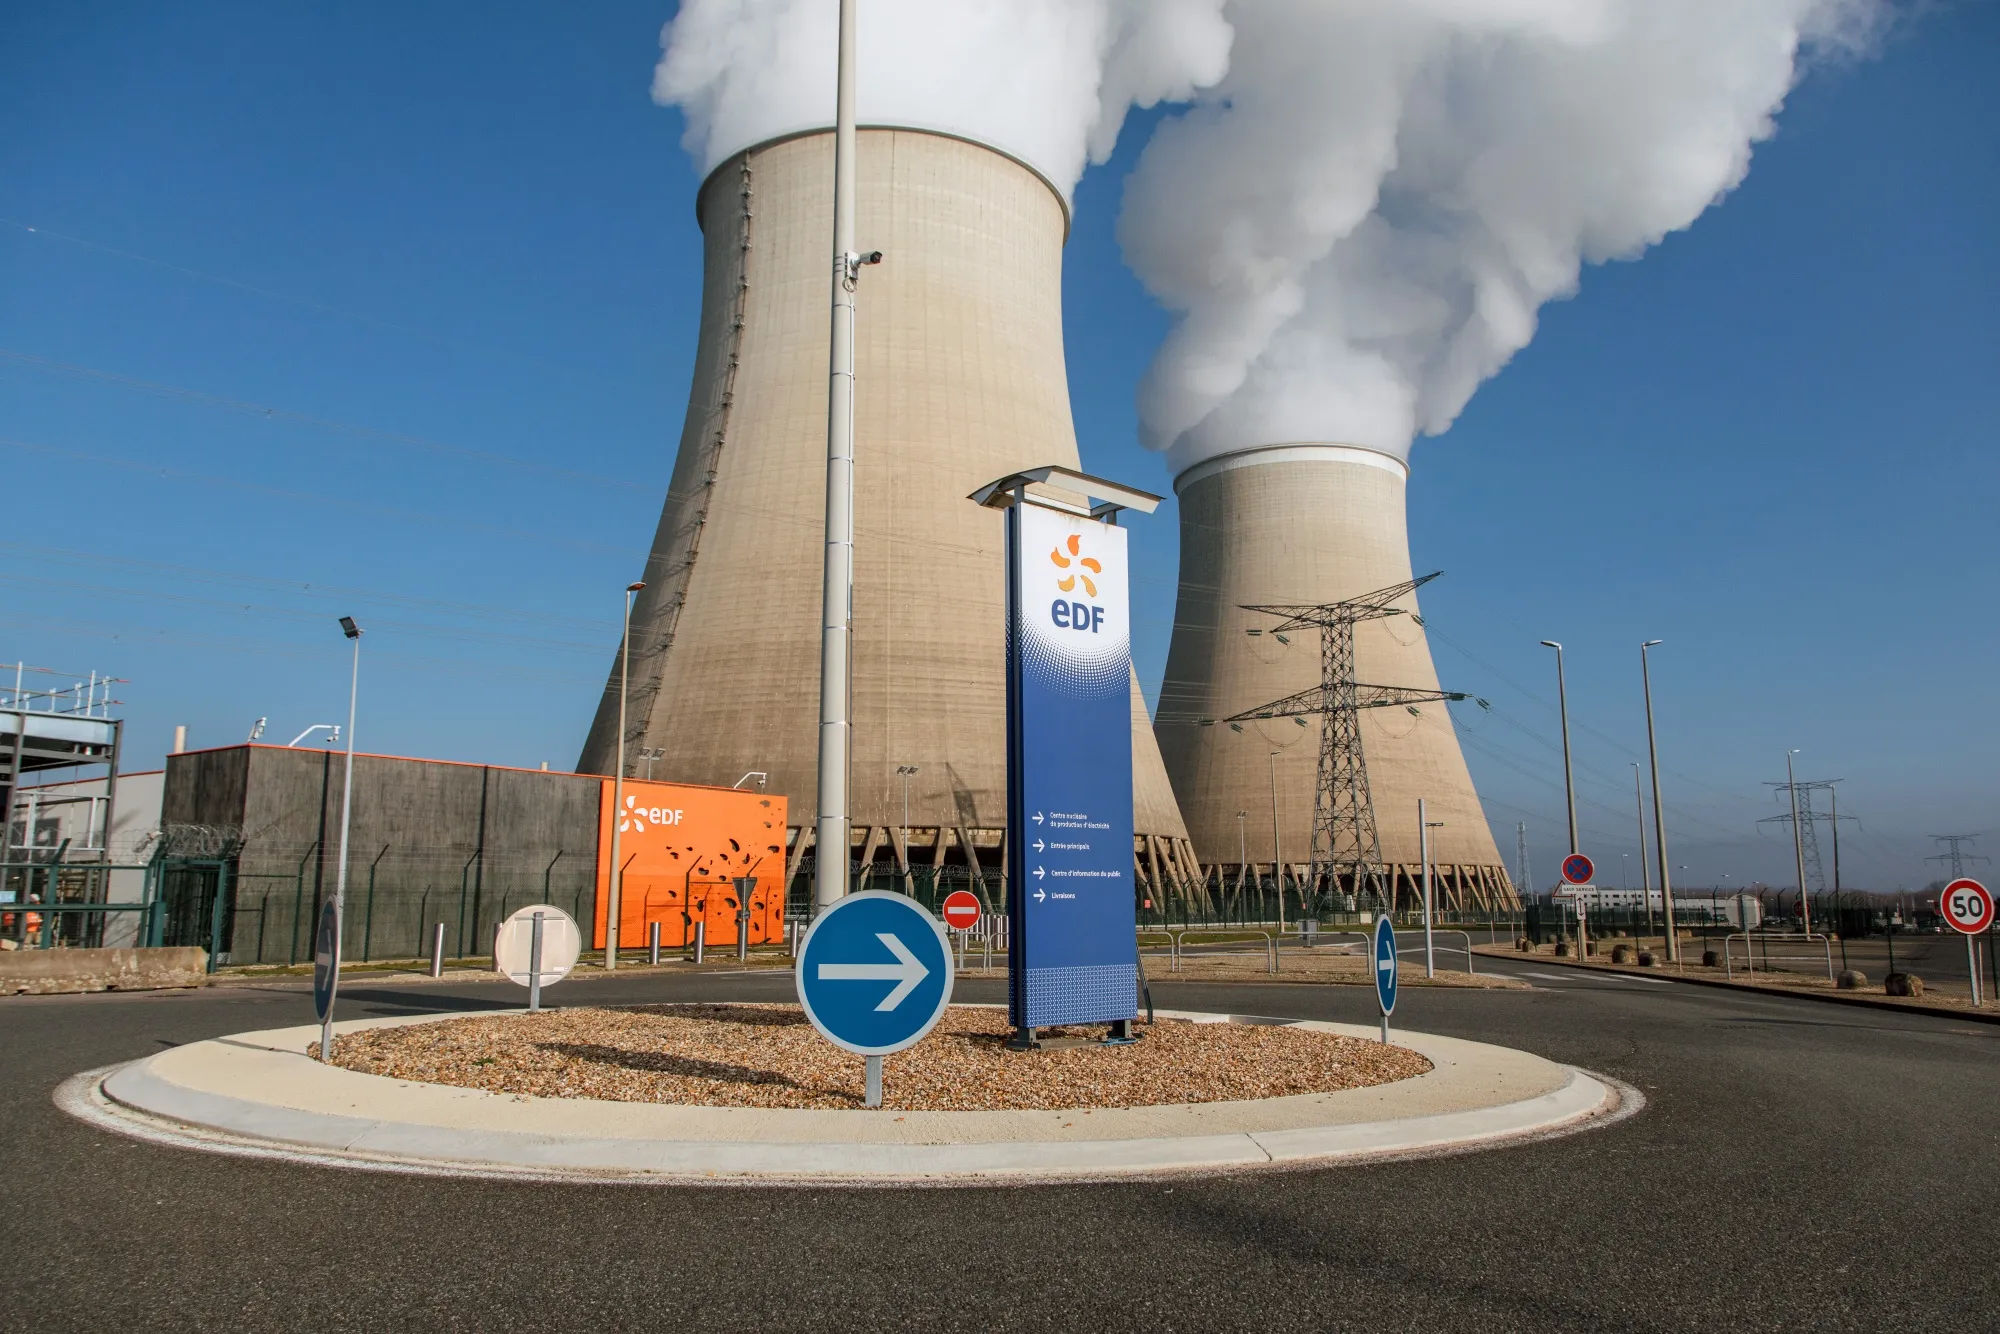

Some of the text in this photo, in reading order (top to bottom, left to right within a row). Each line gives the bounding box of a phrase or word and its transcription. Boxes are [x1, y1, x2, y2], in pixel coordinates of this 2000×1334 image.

[1049, 811, 1088, 820] Centre nucléaire
[1057, 821, 1083, 829] production
[1067, 843, 1090, 851] principale
[1107, 870, 1121, 879] public
[1953, 895, 1983, 918] 50
